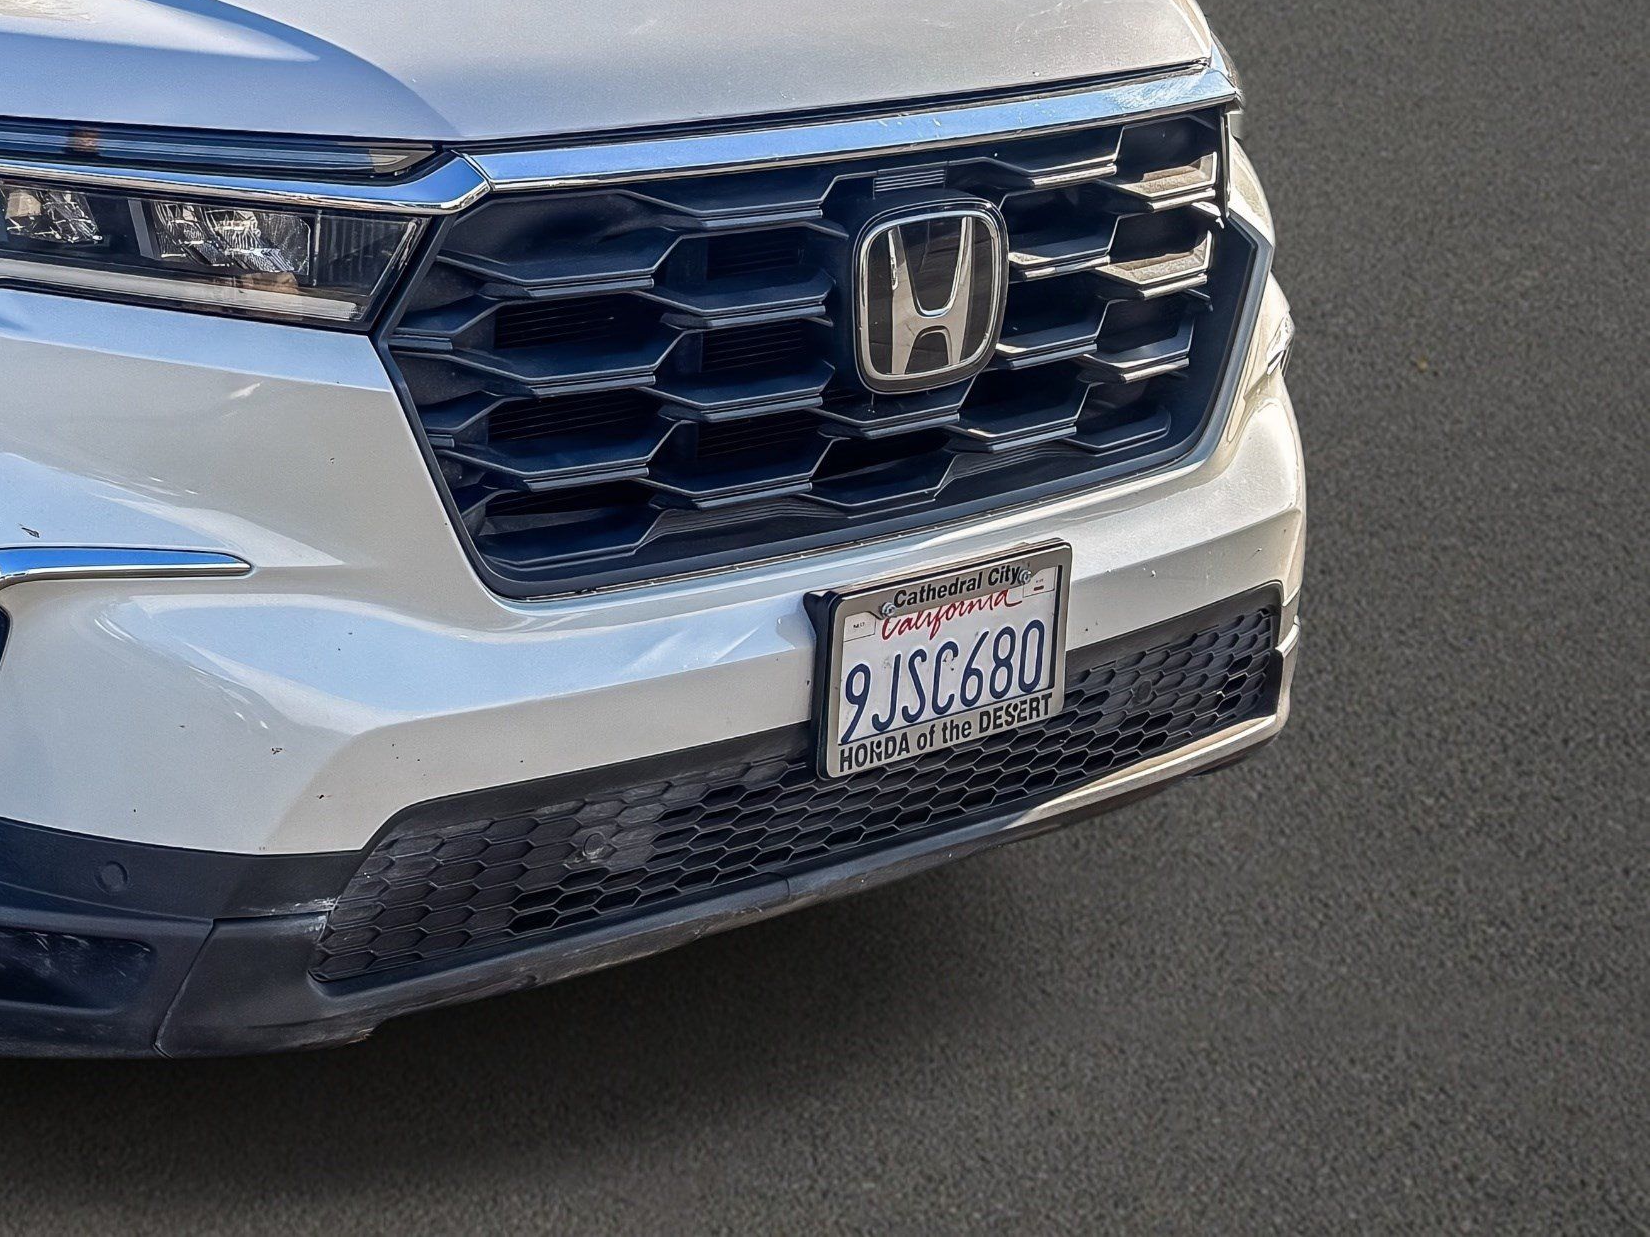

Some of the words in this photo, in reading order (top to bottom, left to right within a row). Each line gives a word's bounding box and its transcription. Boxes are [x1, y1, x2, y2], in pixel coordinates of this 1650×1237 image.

[881, 589, 1023, 640] California
[893, 571, 983, 608] Cathedral
[987, 565, 1022, 587] City
[841, 618, 1046, 745] 9JSC680
[839, 731, 911, 773] HONDA
[916, 723, 936, 751] of
[941, 719, 972, 744] the
[978, 692, 1053, 734] DESERT
